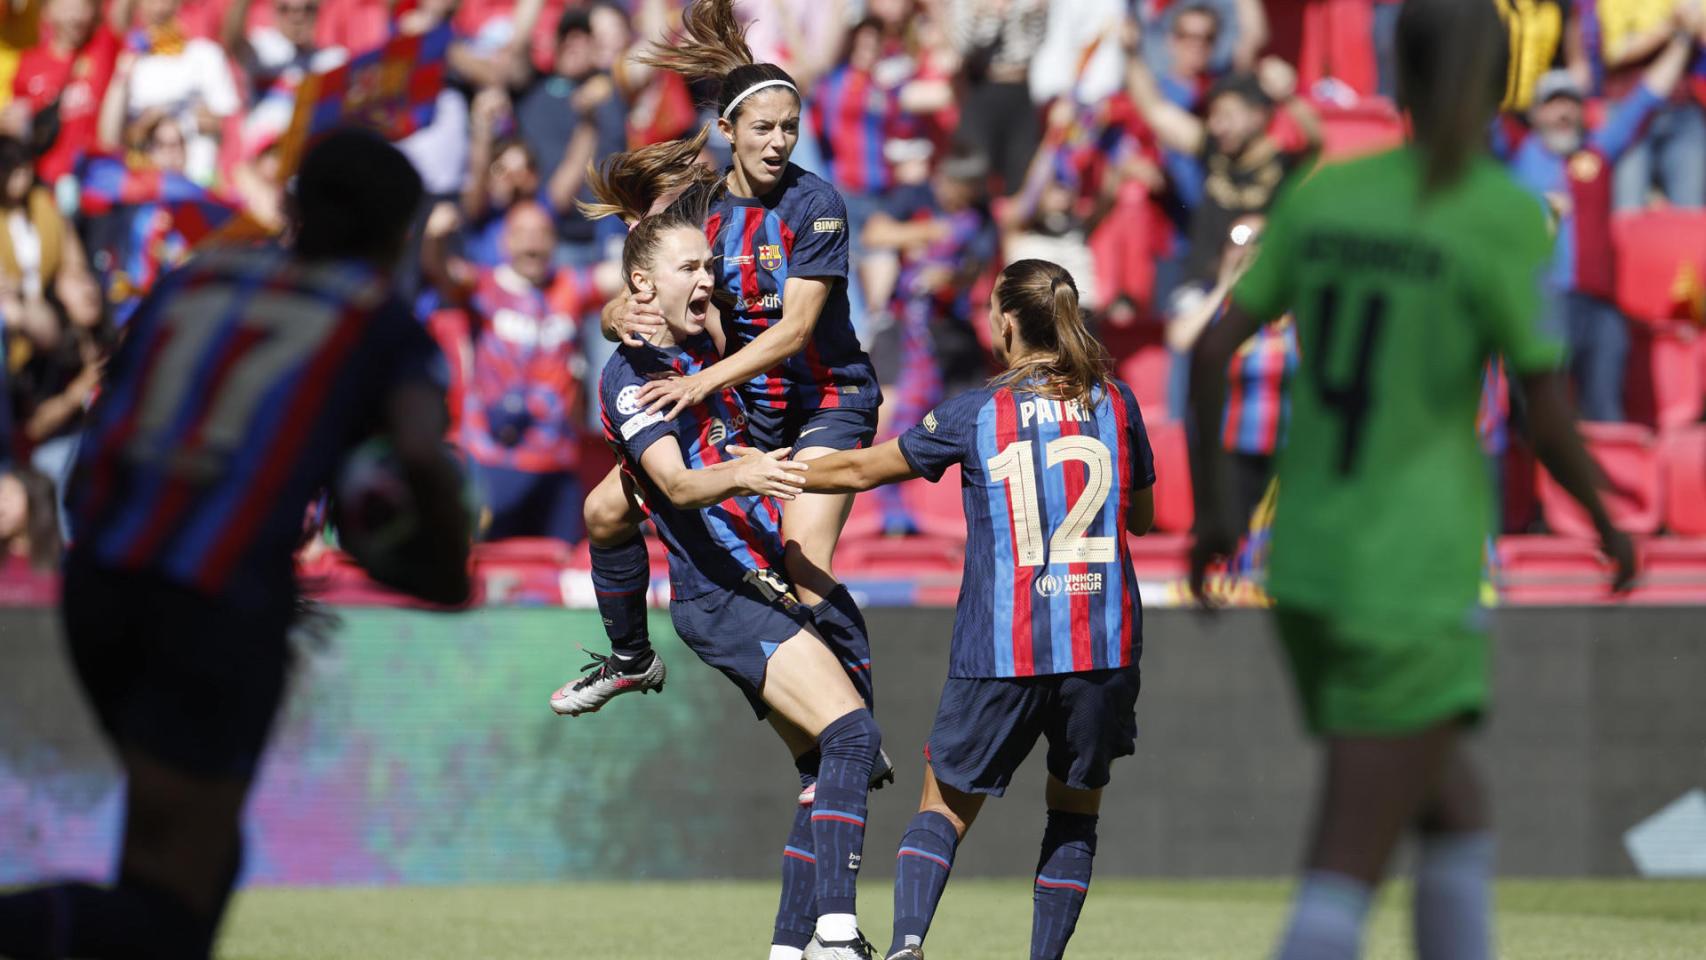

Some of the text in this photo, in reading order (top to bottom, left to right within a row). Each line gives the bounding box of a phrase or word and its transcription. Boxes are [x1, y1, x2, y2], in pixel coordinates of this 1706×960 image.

[138, 290, 338, 447] 17
[1310, 282, 1388, 476] 4
[987, 434, 1115, 567] 12
[1063, 573, 1103, 583] UNHCR
[1063, 581, 1103, 592] ACNUR
